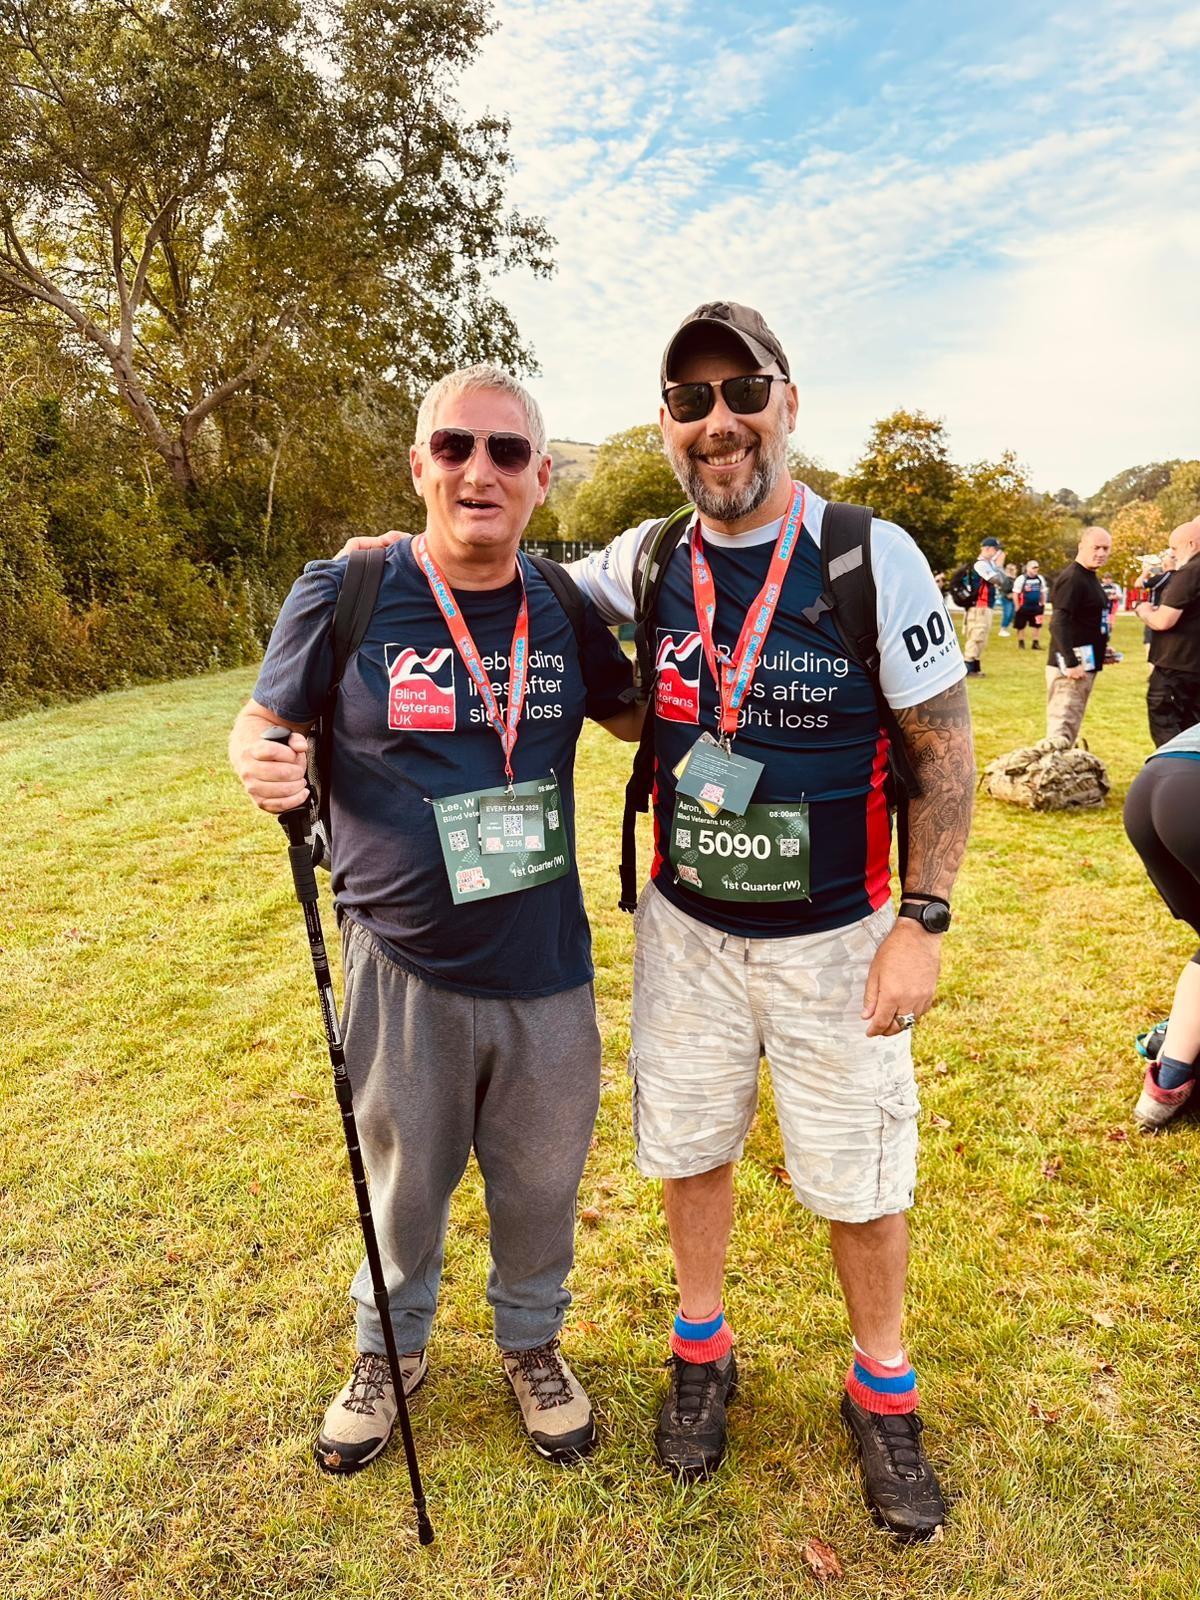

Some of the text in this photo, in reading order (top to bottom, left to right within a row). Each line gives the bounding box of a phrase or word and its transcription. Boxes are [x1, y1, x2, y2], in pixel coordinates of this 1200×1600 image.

[902, 602, 953, 662] DO
[915, 656, 936, 673] FOR
[730, 635, 763, 709] CHALLENGER
[395, 688, 427, 700] Blind
[772, 681, 838, 703] after
[657, 692, 694, 708] terans
[394, 702, 451, 714] Veterans
[526, 701, 563, 720] loss
[394, 714, 412, 726] UK
[780, 708, 829, 729] loss
[463, 798, 475, 808] W
[486, 805, 507, 813] EVENT
[678, 801, 702, 815] Aaron,
[443, 811, 479, 824] Blind Vete
[677, 812, 691, 821] Blind
[690, 815, 719, 826] Veterans
[698, 829, 771, 860] 5090
[511, 866, 526, 878] 1st
[723, 880, 740, 890] 1st
